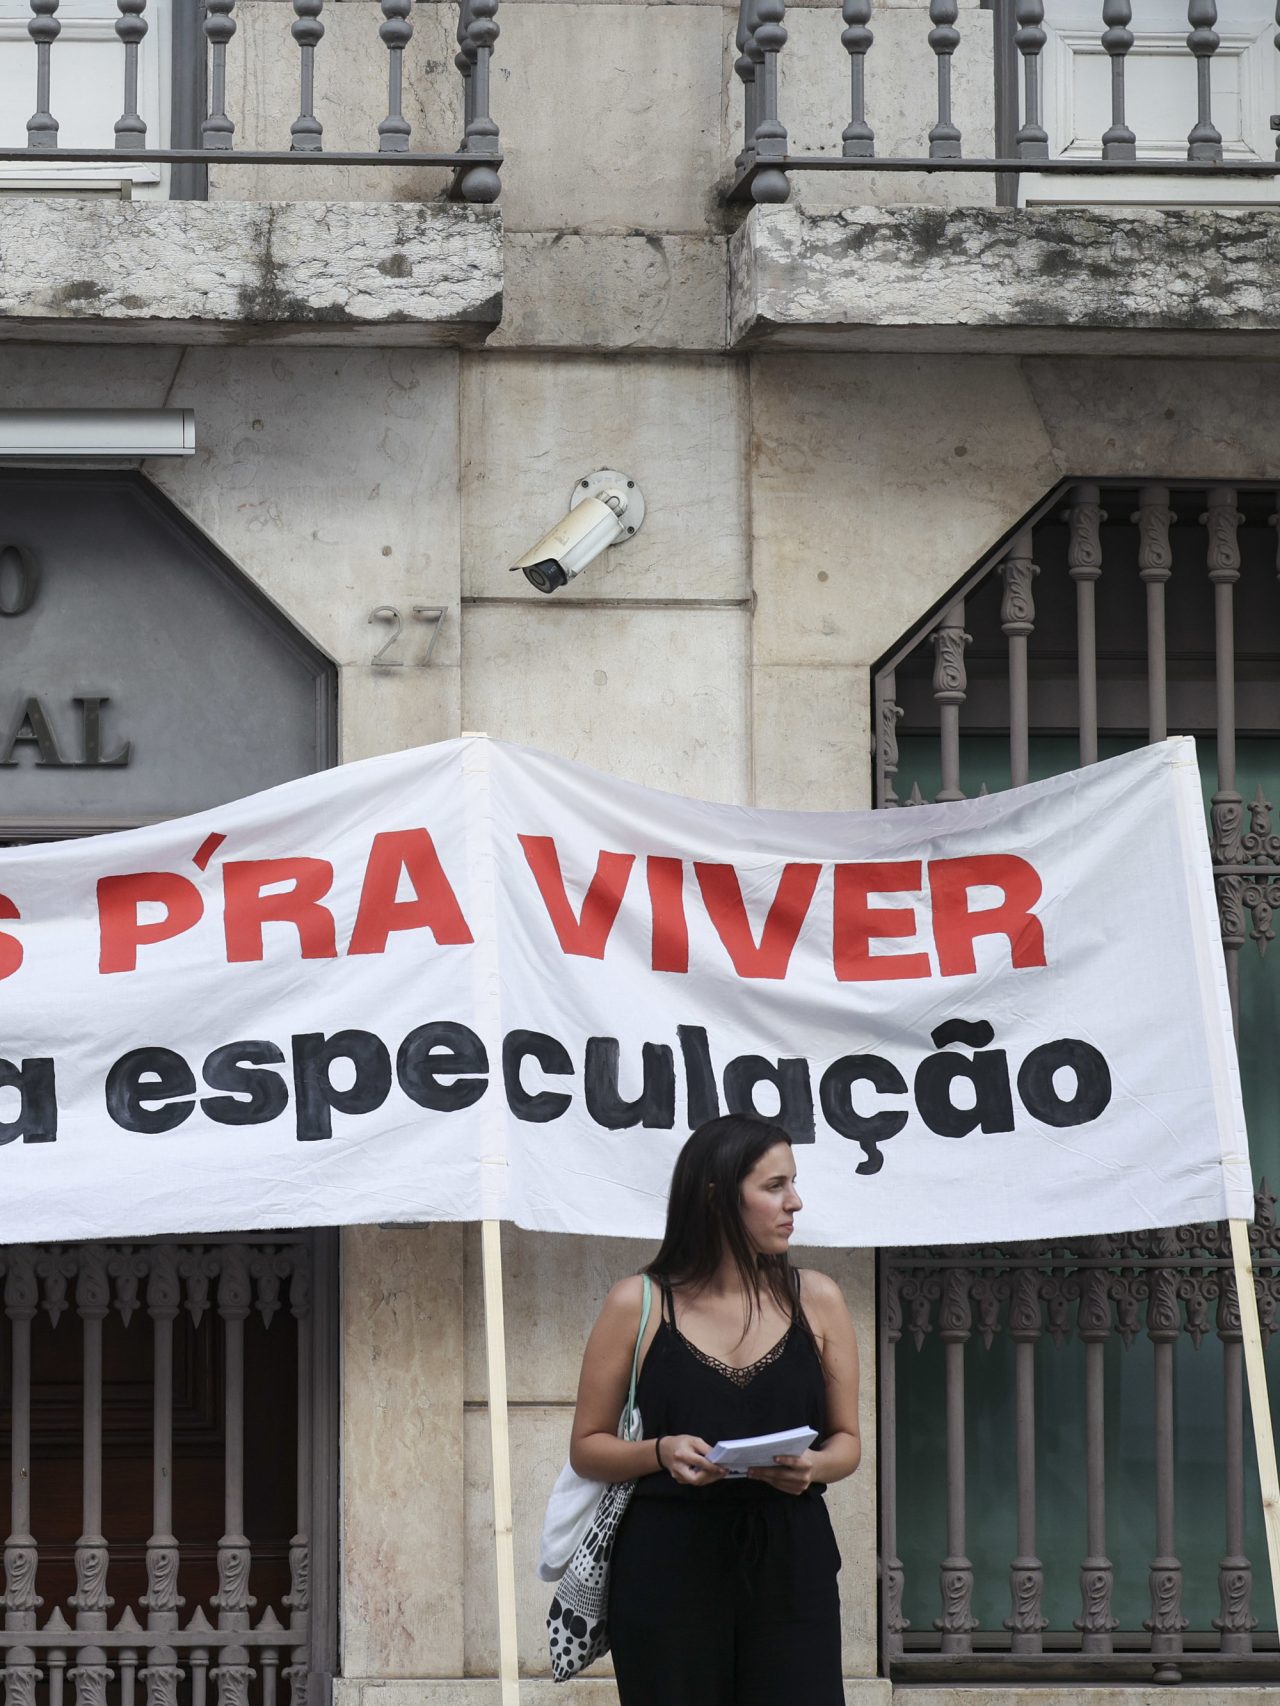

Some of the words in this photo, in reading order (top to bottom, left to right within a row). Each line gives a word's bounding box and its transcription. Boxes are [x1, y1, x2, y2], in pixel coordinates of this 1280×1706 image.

[367, 605, 449, 667] 27
[519, 835, 1046, 982] VIVER
[105, 1018, 1112, 1176] especulação
